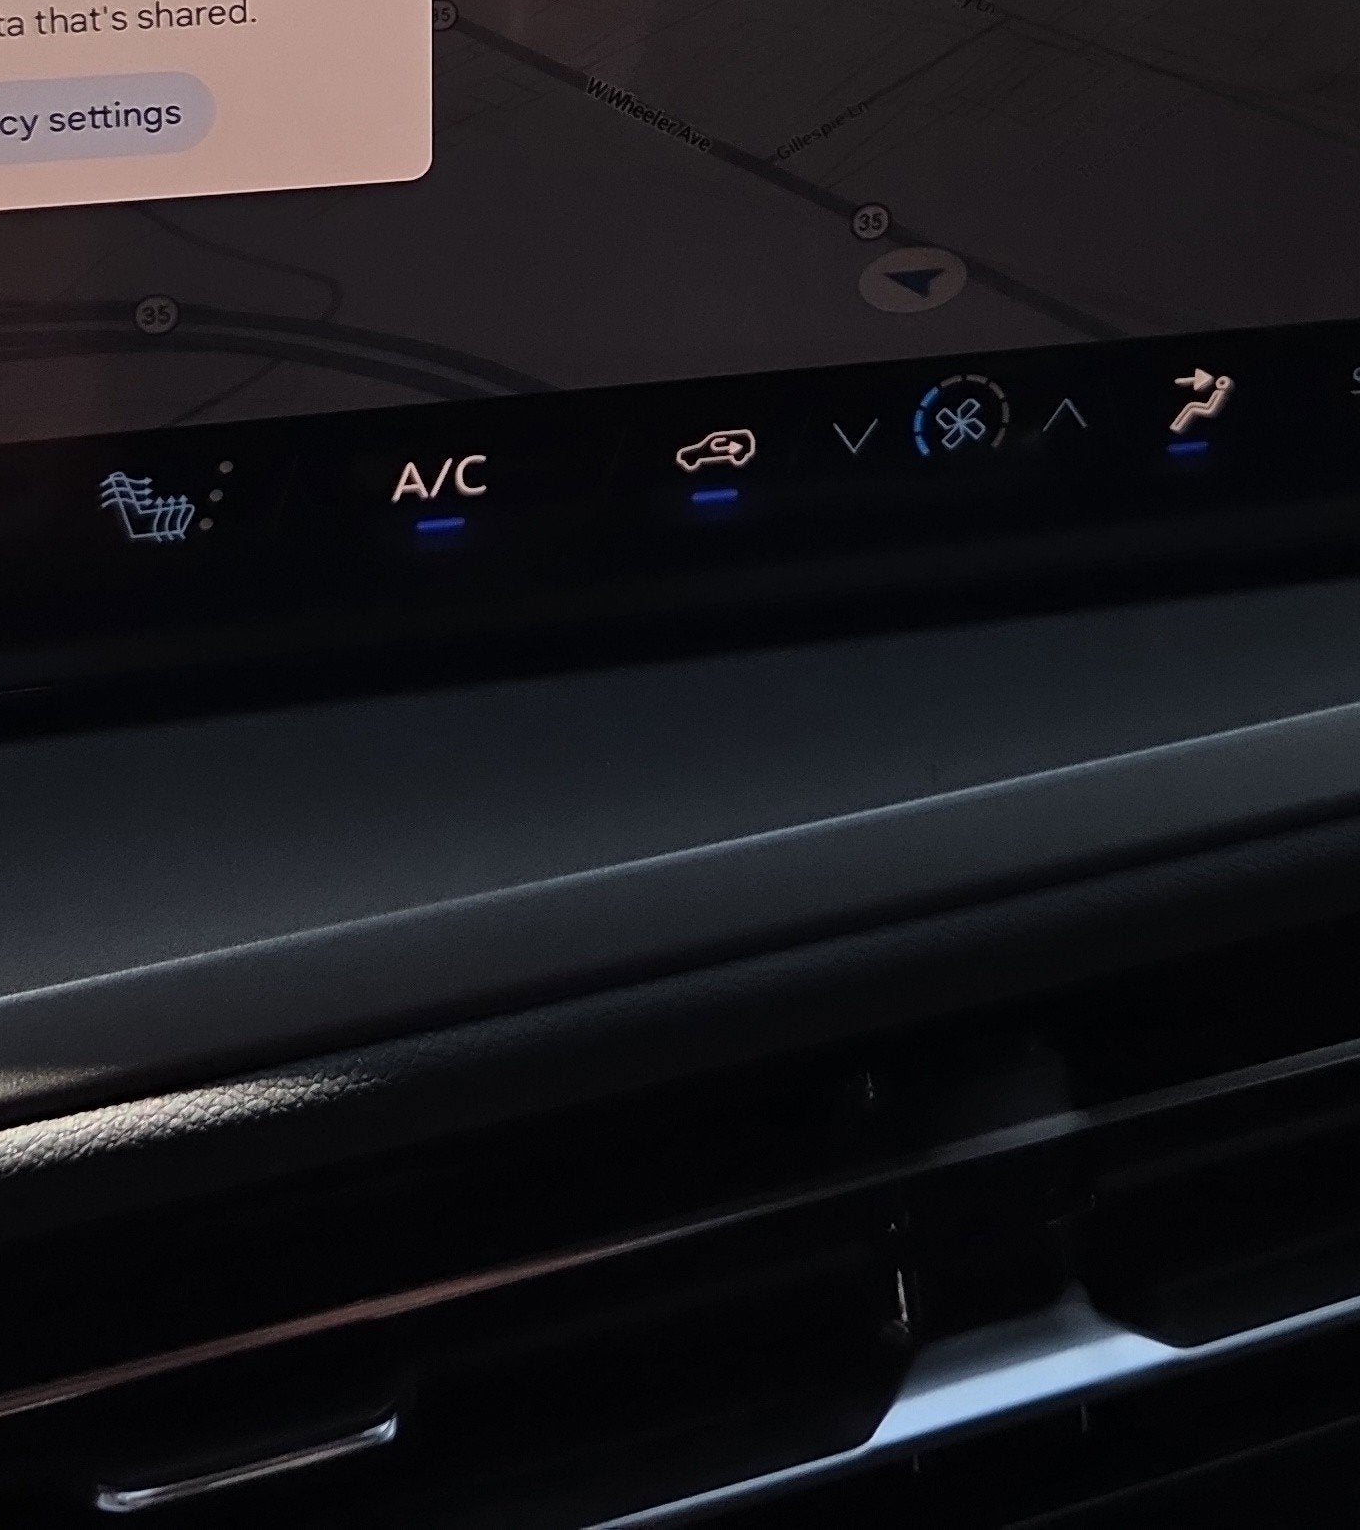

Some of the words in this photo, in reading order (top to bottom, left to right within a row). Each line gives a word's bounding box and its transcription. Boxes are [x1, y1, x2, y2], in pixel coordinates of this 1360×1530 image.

[34, 6, 128, 35] that's
[49, 101, 181, 137] settings
[587, 76, 609, 98] W
[607, 86, 677, 135] Wheeler
[678, 125, 712, 152] Ave
[776, 114, 846, 160] Gillespie
[846, 100, 869, 119] Ln
[857, 212, 884, 232] 35
[141, 304, 172, 326] 35
[391, 454, 488, 502] A/C
